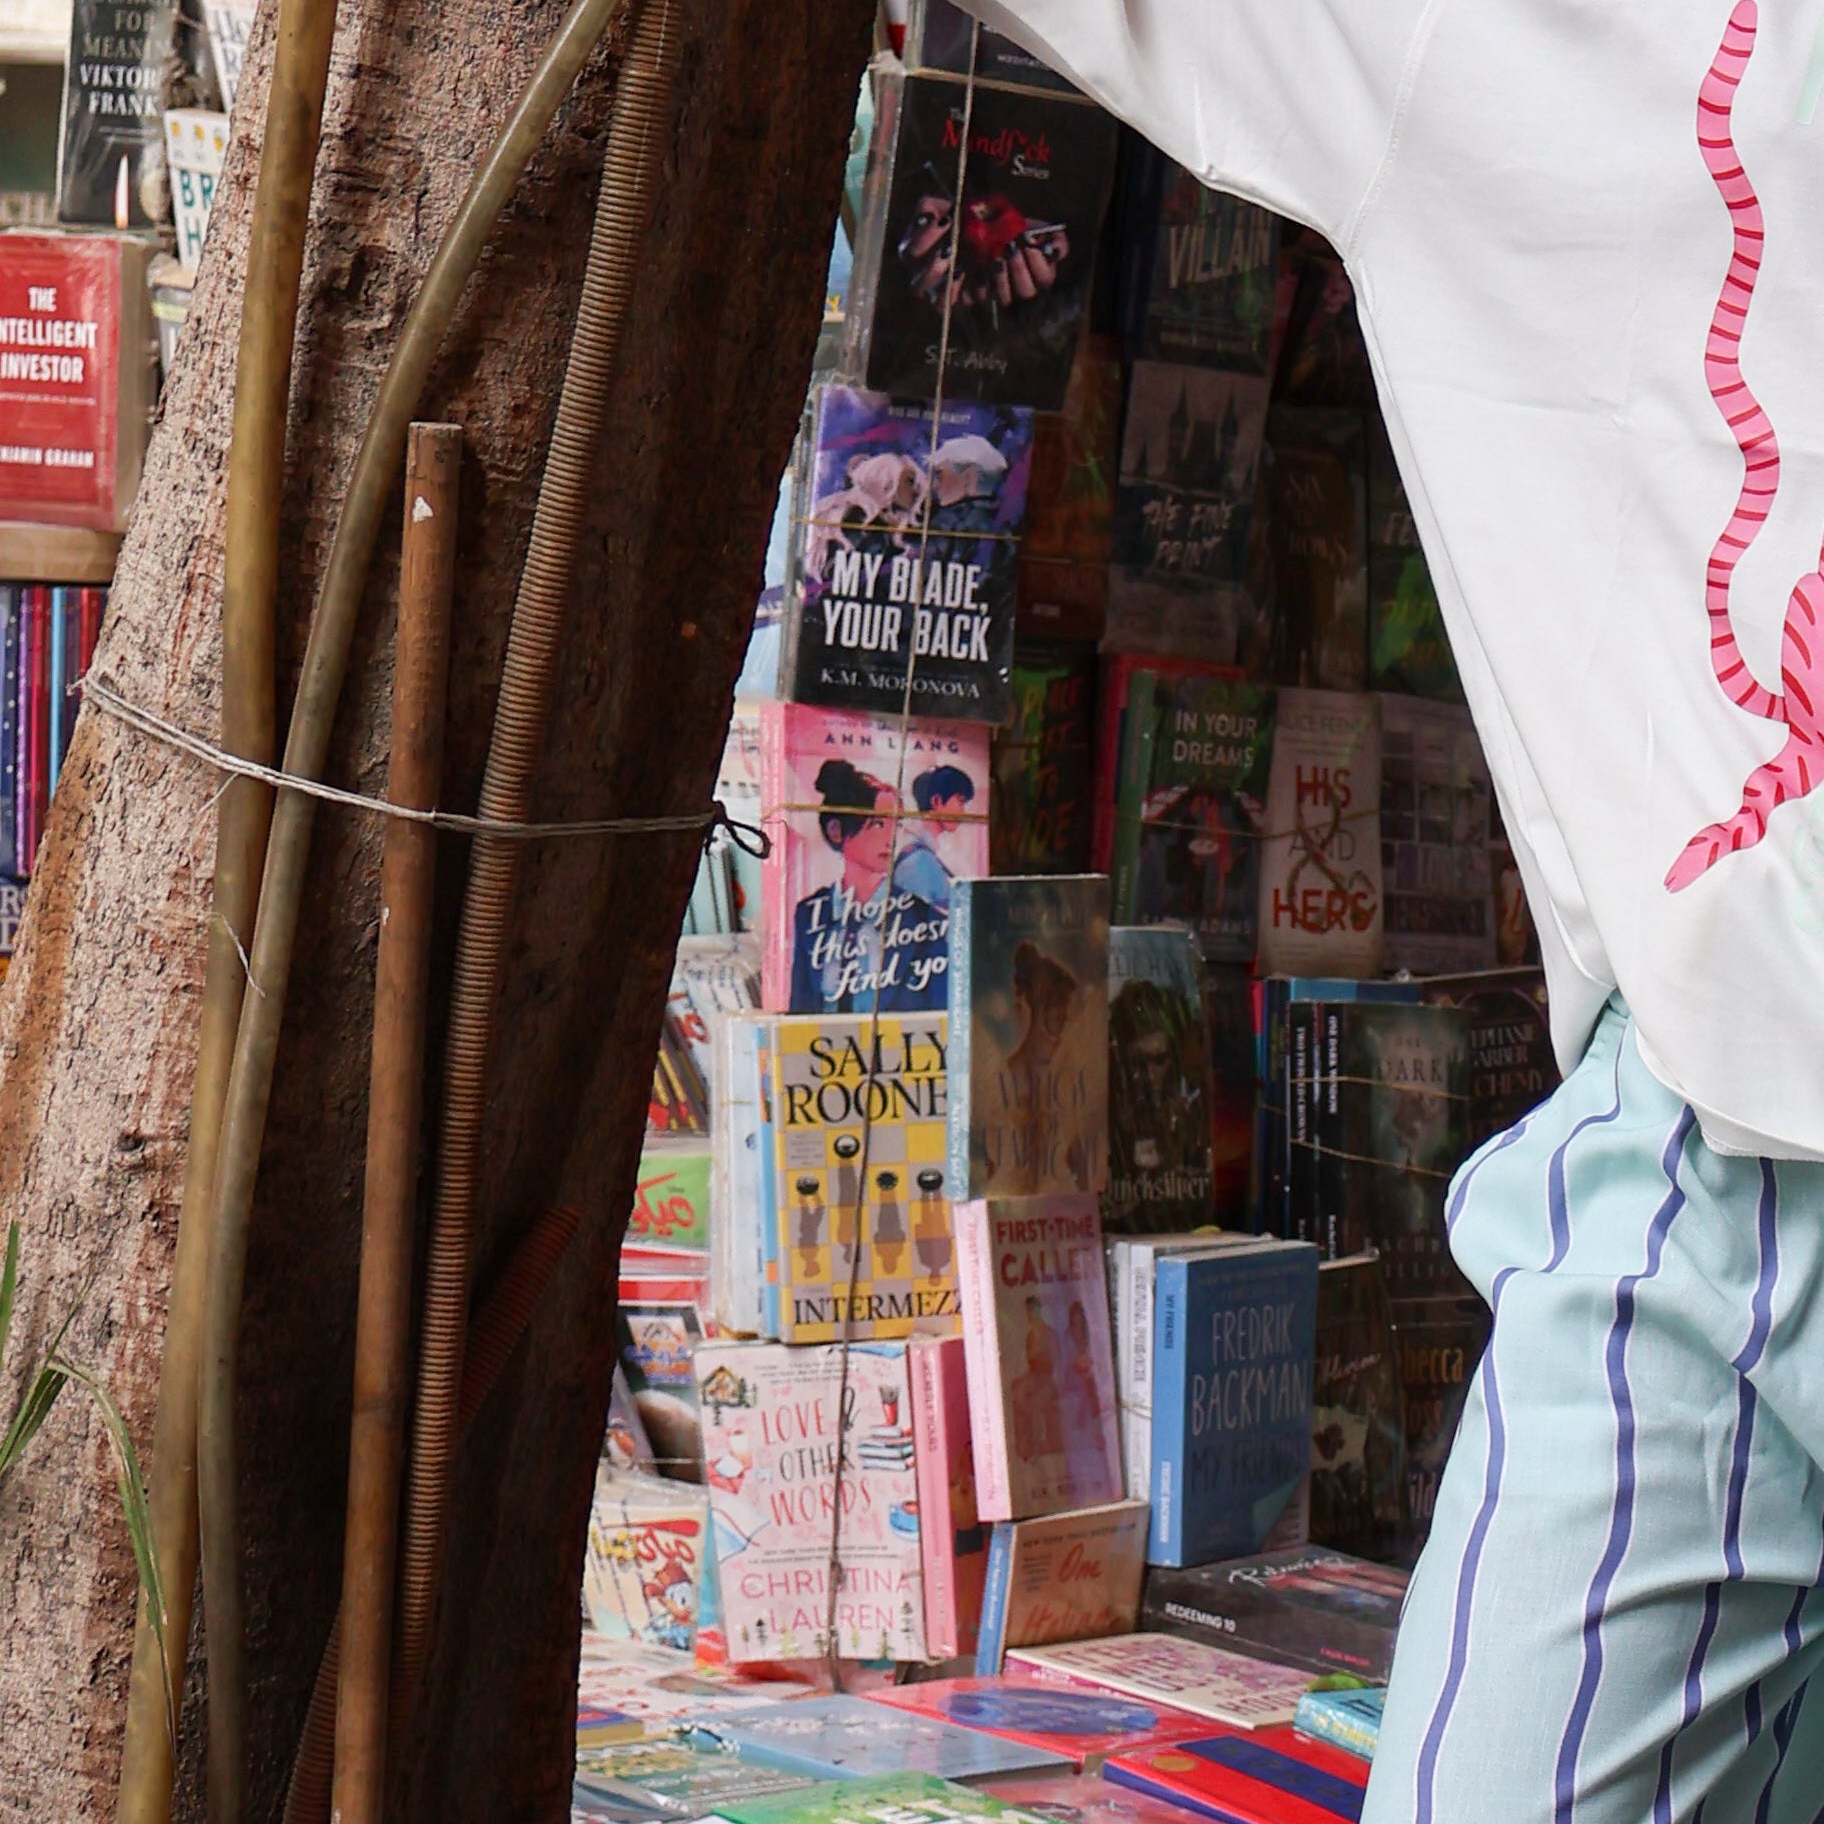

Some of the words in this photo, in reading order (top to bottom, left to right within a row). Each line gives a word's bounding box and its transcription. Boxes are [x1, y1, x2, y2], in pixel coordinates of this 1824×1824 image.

[79, 62, 162, 90] VIKTOR
[1168, 209, 1273, 290] VILLAIN
[28, 286, 57, 312] THE
[0, 318, 99, 349] NTELLIGENT
[1, 352, 84, 384] INVESTOR
[44, 447, 95, 469] GRAHAM
[831, 548, 883, 599] MY
[823, 599, 902, 654] YOUR
[913, 611, 993, 663] BACK
[825, 733, 872, 748] ANN
[888, 737, 960, 755] LANG
[1173, 710, 1200, 734] IN
[1203, 711, 1259, 742] YOUR
[1171, 738, 1256, 769] DREAMS
[1295, 763, 1351, 809] HIS
[807, 895, 830, 935] I
[838, 883, 915, 929] hope
[1272, 887, 1378, 935] HERS
[811, 929, 870, 971] this
[823, 951, 900, 1003] find
[808, 1030, 949, 1079] SALLY
[784, 1076, 948, 1126] ROONE
[632, 1172, 696, 1236] ميك
[996, 1215, 1096, 1245] FIRST-TIME
[1000, 1246, 1098, 1288] CALLER
[1211, 1301, 1295, 1366] FREDRIK
[1191, 1361, 1308, 1437] BACKMAN
[761, 1396, 827, 1447] LOVE
[779, 1441, 855, 1483] OTHER
[770, 1478, 872, 1527] WORDS
[740, 1566, 914, 1600] CHRITINA
[1058, 1541, 1103, 1584] One
[769, 1600, 894, 1635] LAUREN
